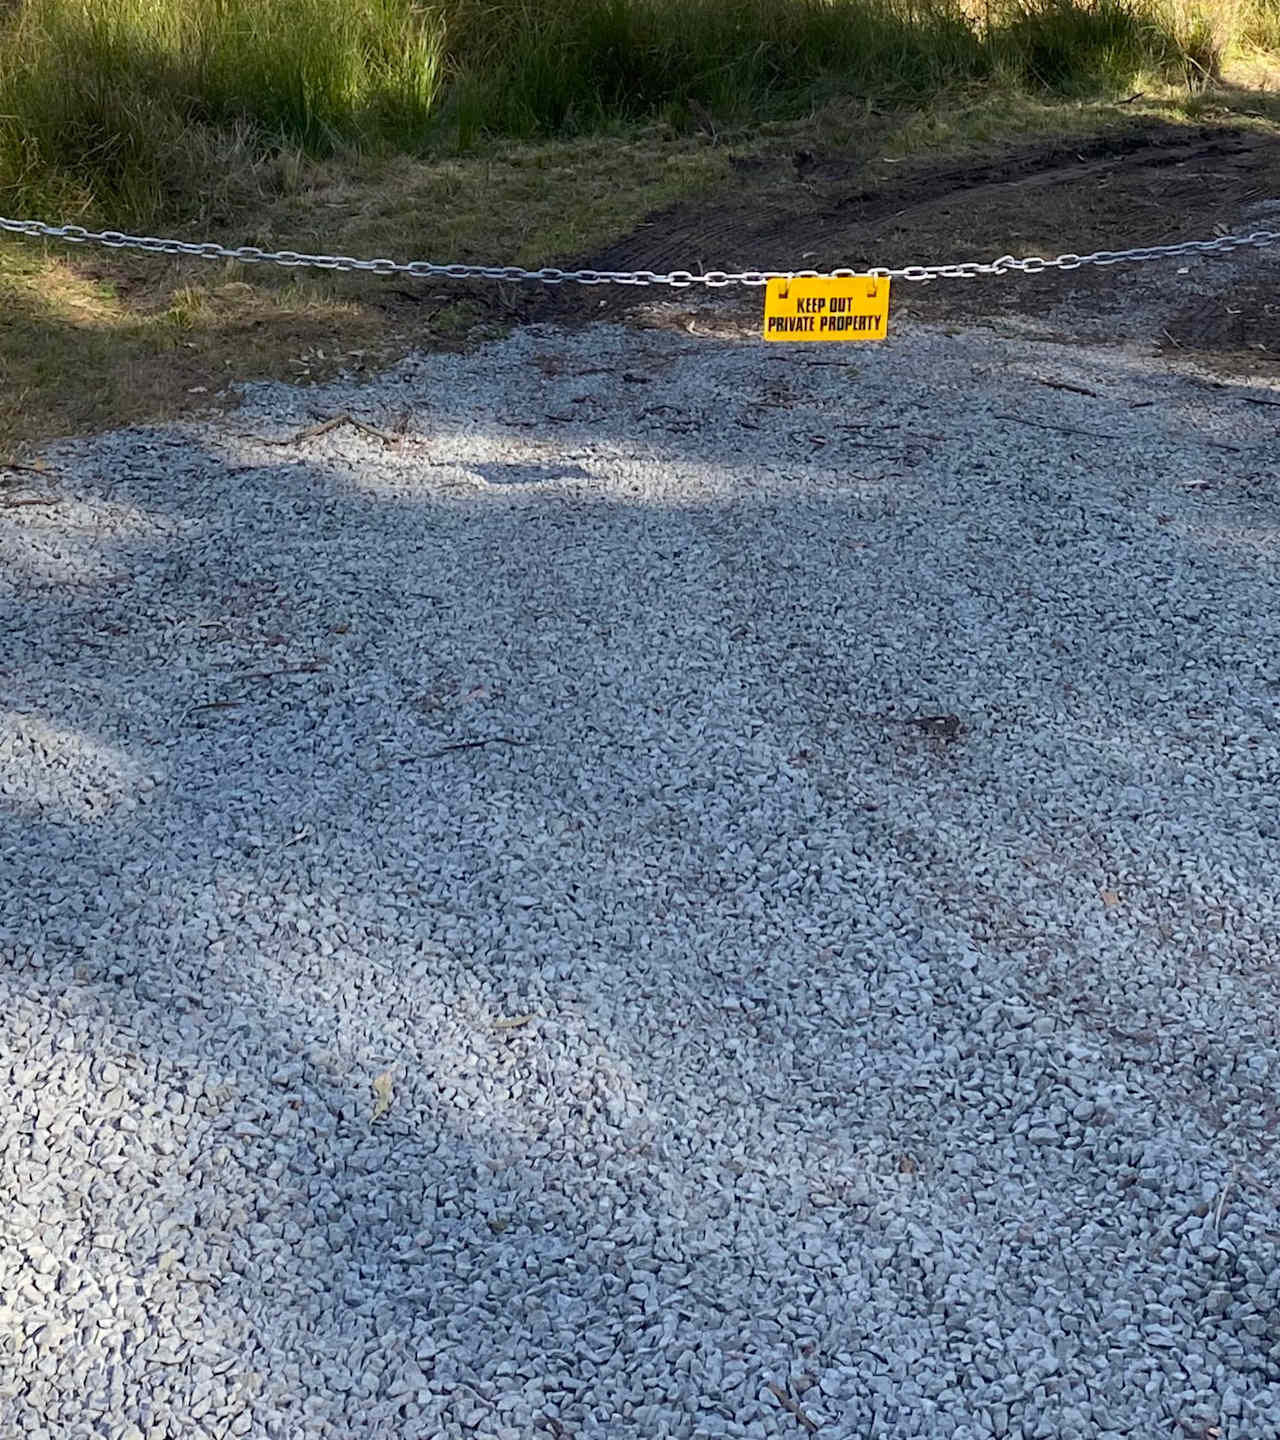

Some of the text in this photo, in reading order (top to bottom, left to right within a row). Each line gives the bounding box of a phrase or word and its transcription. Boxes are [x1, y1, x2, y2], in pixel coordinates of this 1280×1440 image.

[797, 297, 853, 313] KEEP OUT
[768, 315, 881, 332] PRIVATE PROPERTY
